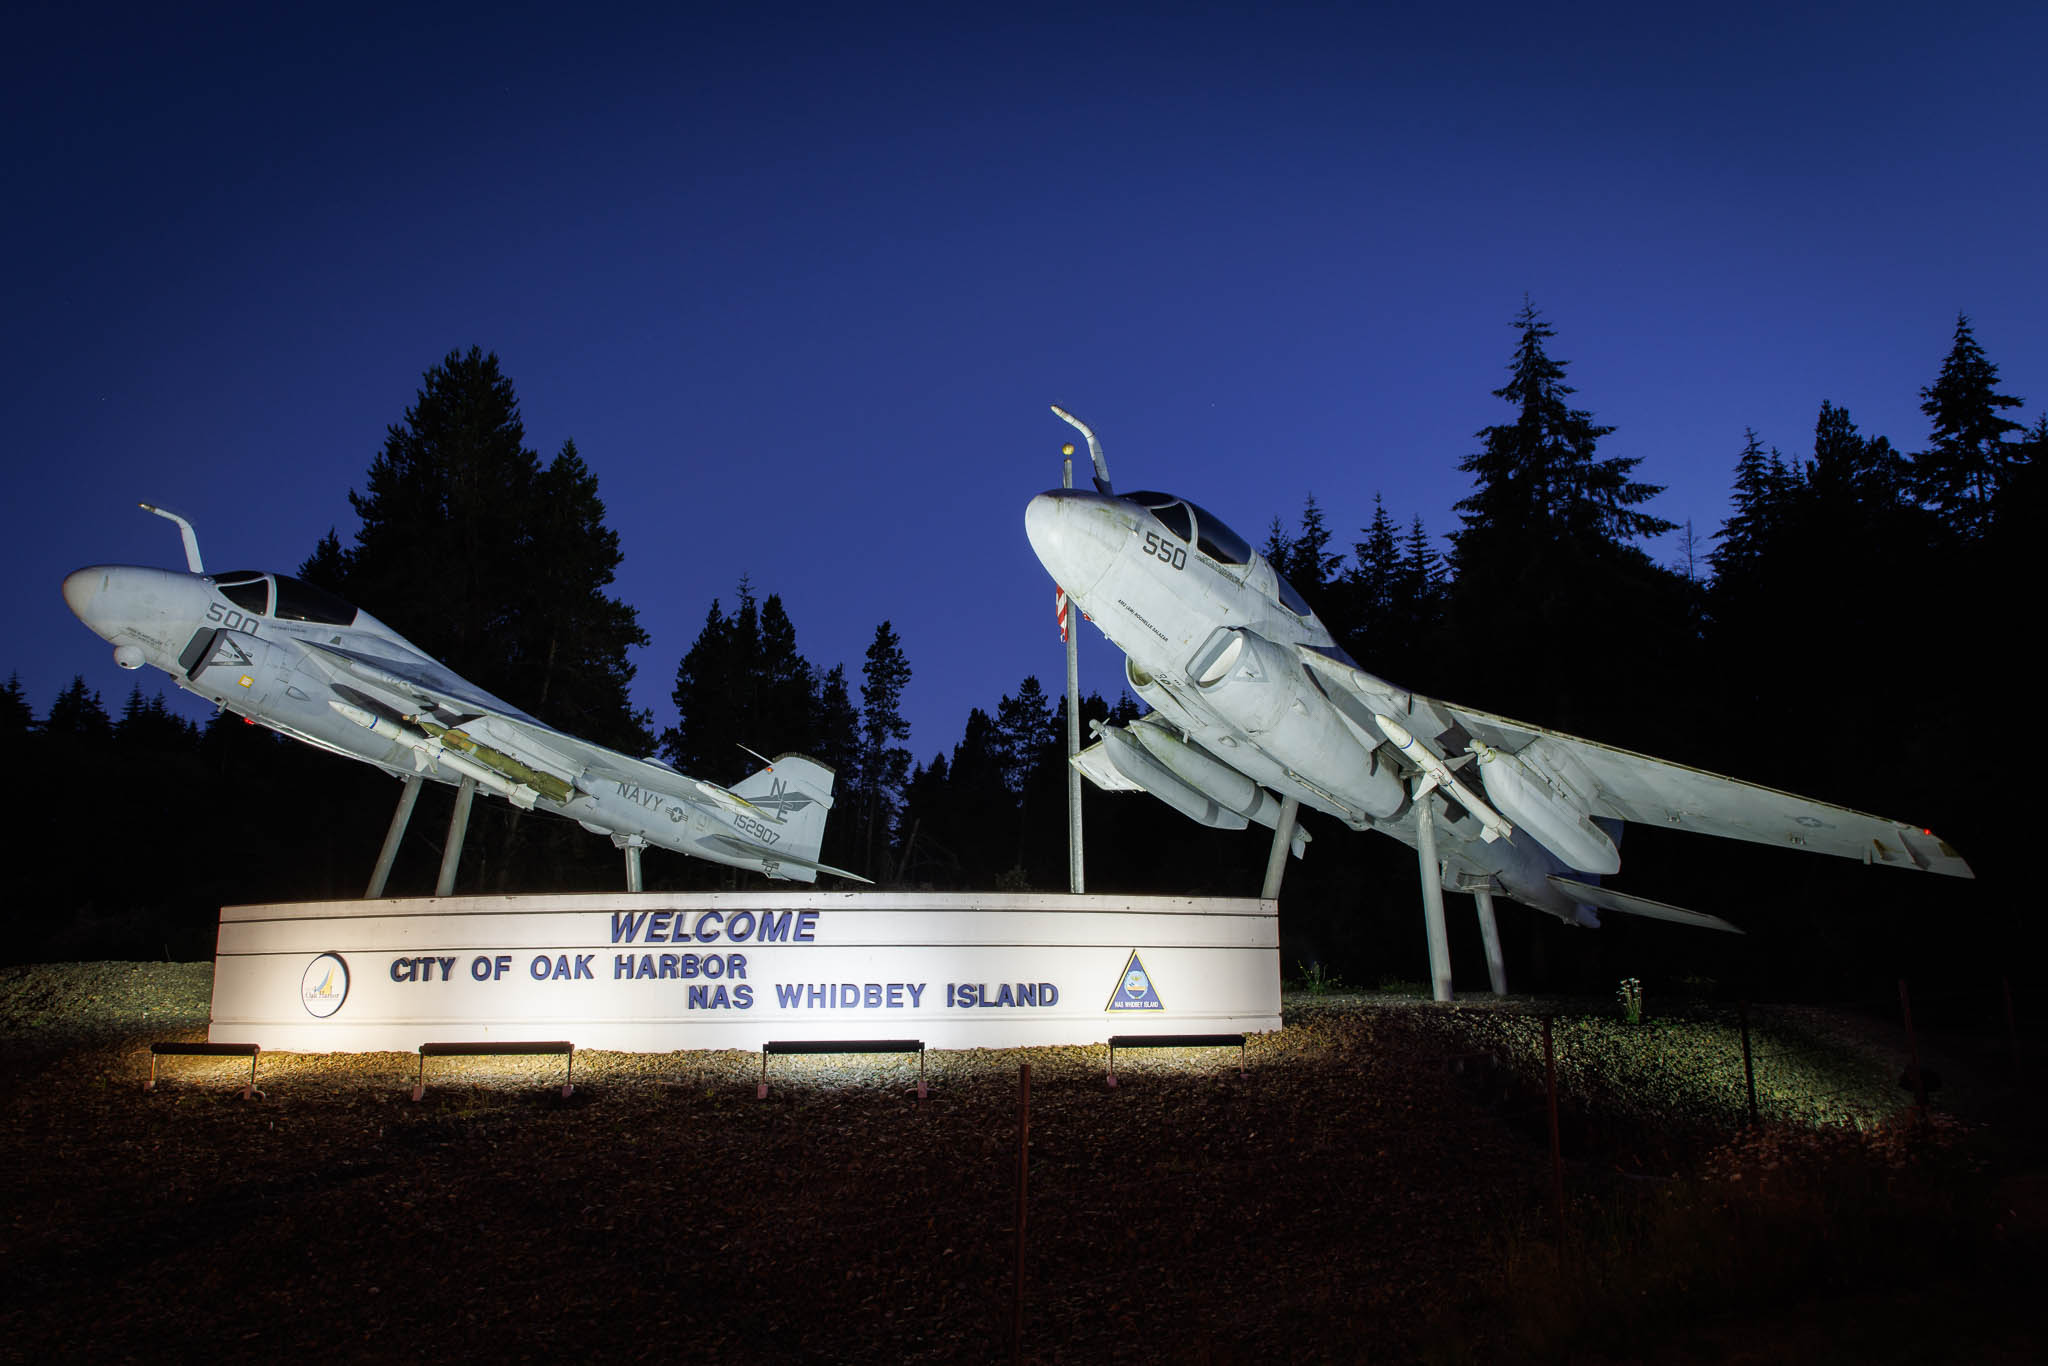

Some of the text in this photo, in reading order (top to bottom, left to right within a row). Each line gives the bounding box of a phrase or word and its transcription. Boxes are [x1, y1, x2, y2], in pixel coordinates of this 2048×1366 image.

[1143, 531, 1187, 571] 550
[206, 601, 260, 637] 500
[1134, 612, 1154, 630] ROCHELLE
[1152, 627, 1169, 642] SALAZAR
[616, 782, 664, 811] NAVY
[733, 814, 781, 845] 152907
[611, 911, 820, 943] WELCOME
[390, 953, 747, 982] CITY OF OAK HARBOR
[688, 982, 1059, 1010] NAS WHIDBEY ISLAND
